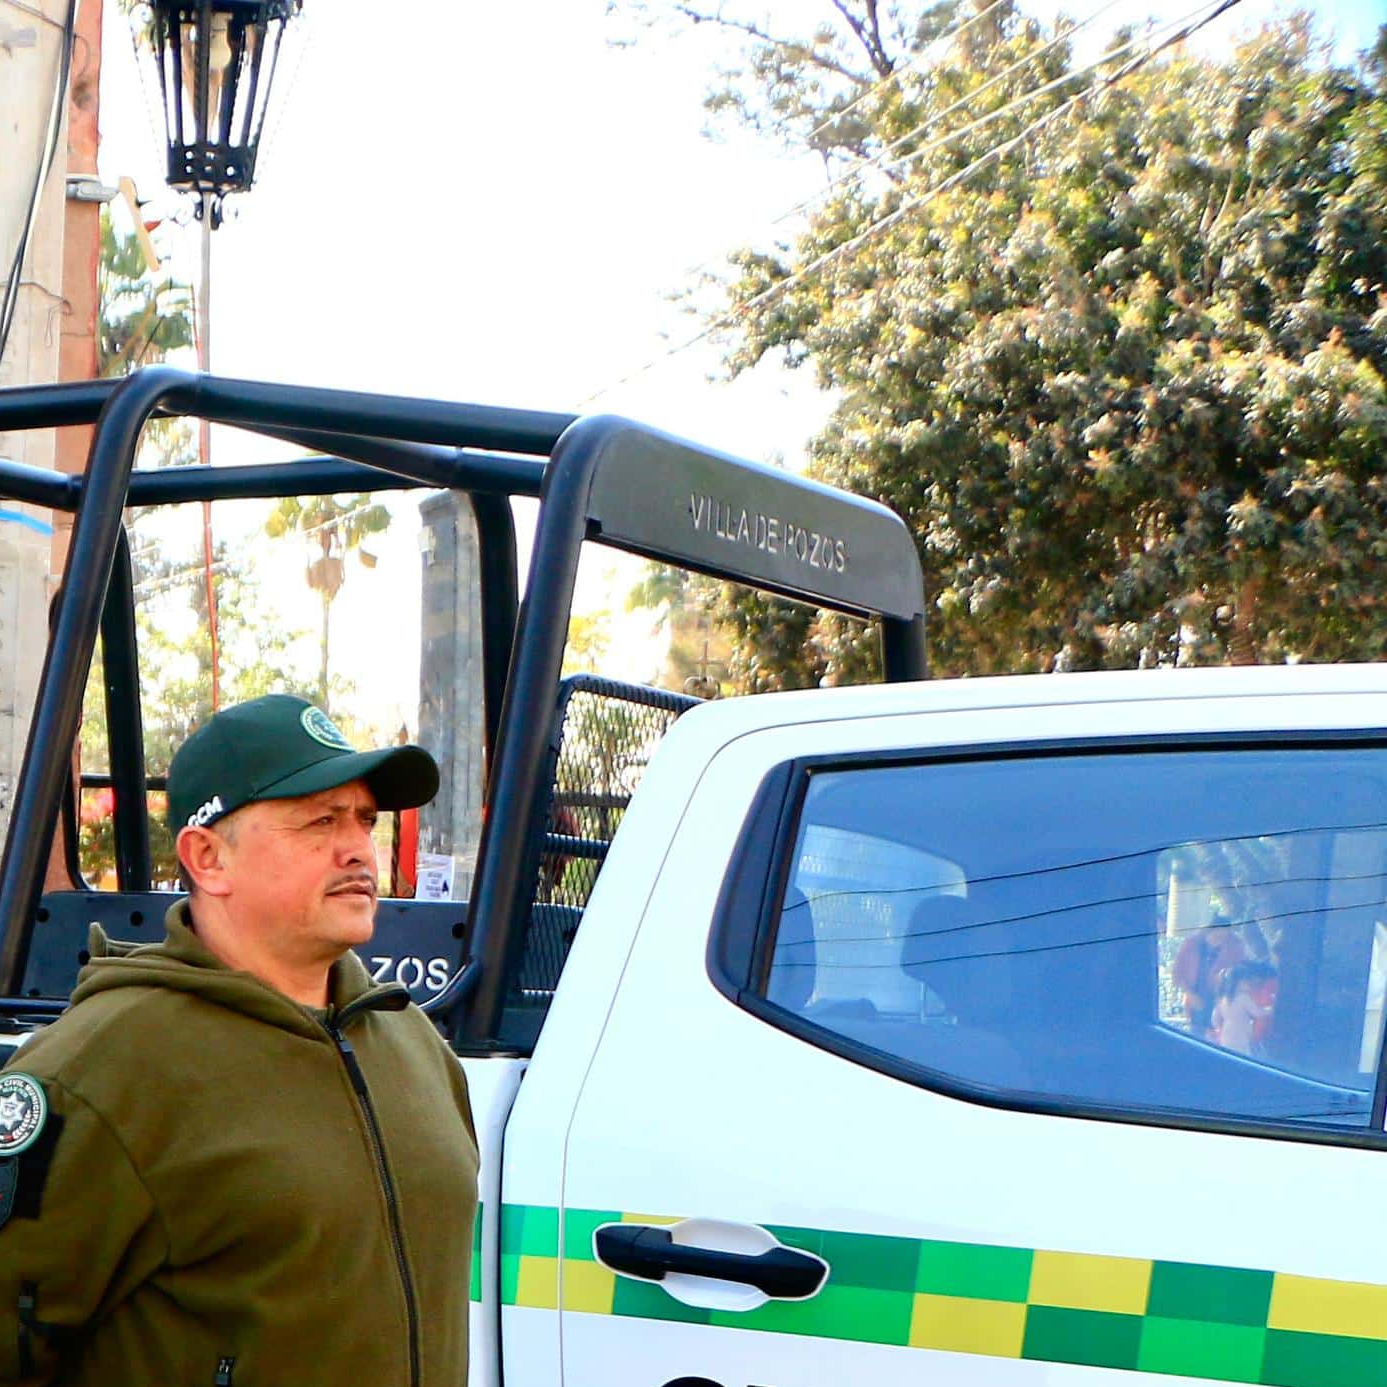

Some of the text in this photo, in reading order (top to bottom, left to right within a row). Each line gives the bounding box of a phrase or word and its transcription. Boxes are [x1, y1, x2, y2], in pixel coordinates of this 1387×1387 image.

[690, 493, 846, 573] VILLA DE POZOS
[370, 957, 449, 991] ZOS
